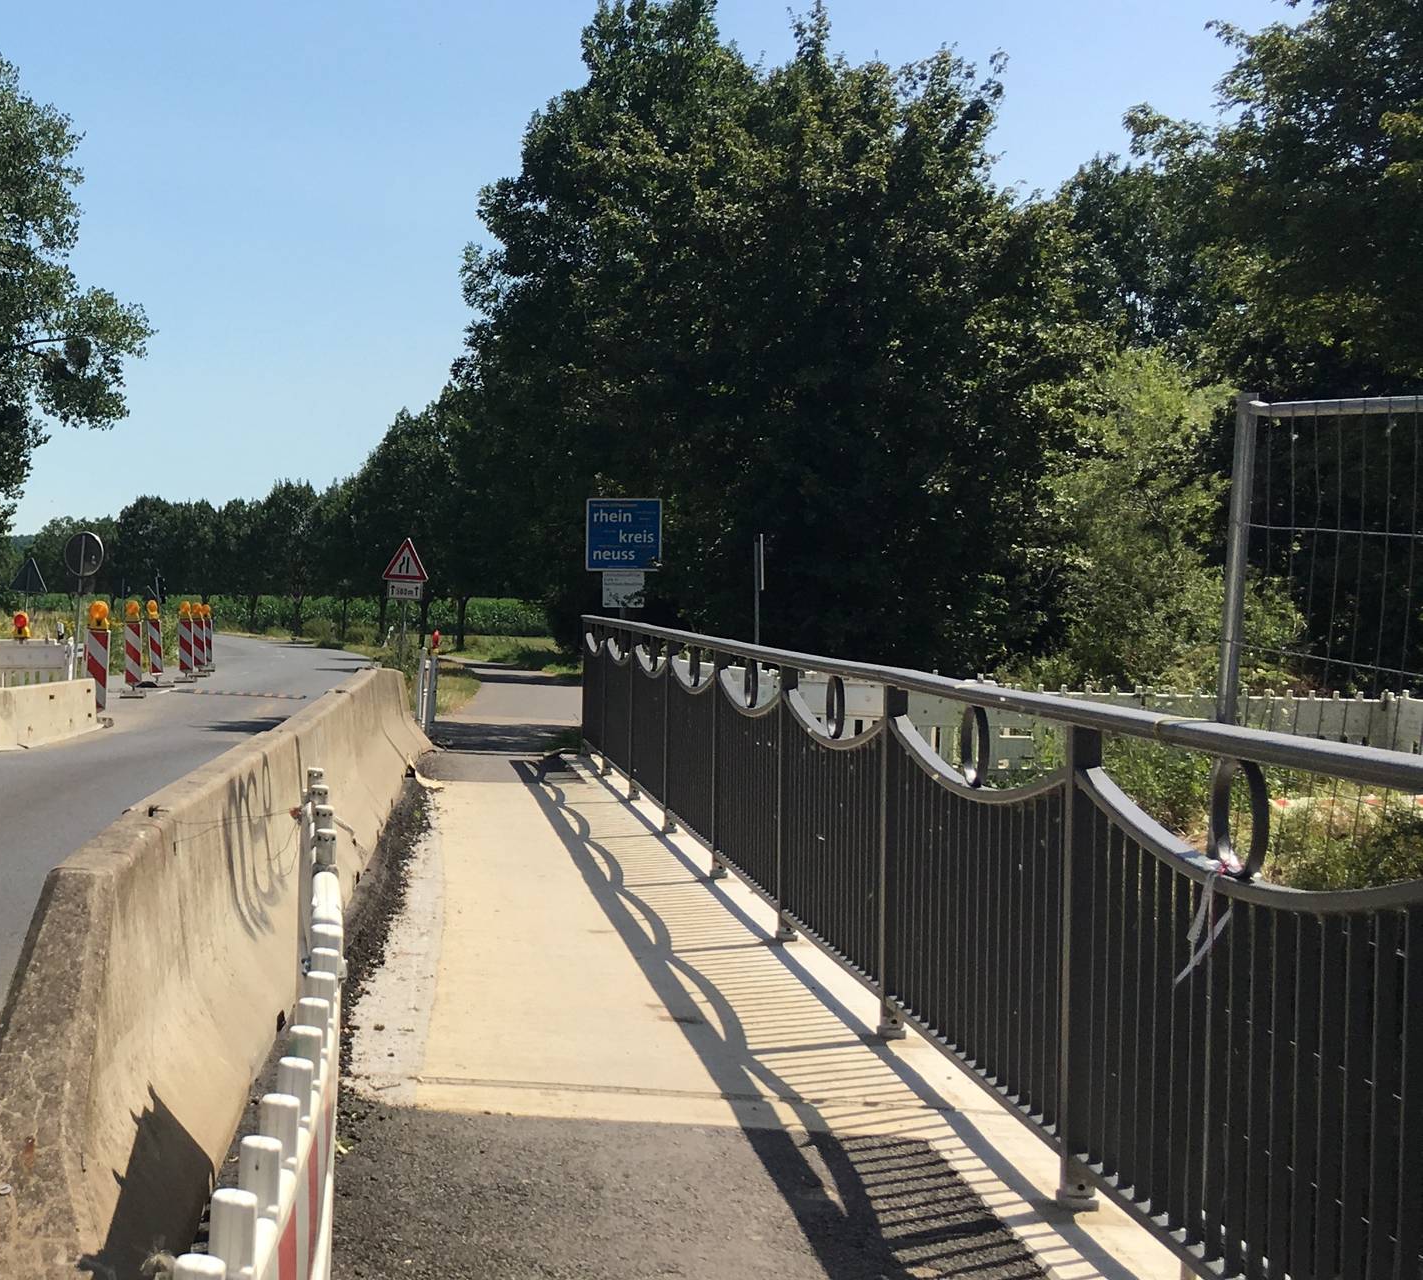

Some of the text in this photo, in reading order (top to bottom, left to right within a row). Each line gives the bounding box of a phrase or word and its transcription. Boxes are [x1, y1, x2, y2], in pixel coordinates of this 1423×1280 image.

[593, 509, 632, 522] rhein
[618, 529, 654, 543] kreis
[592, 549, 636, 560] neuss
